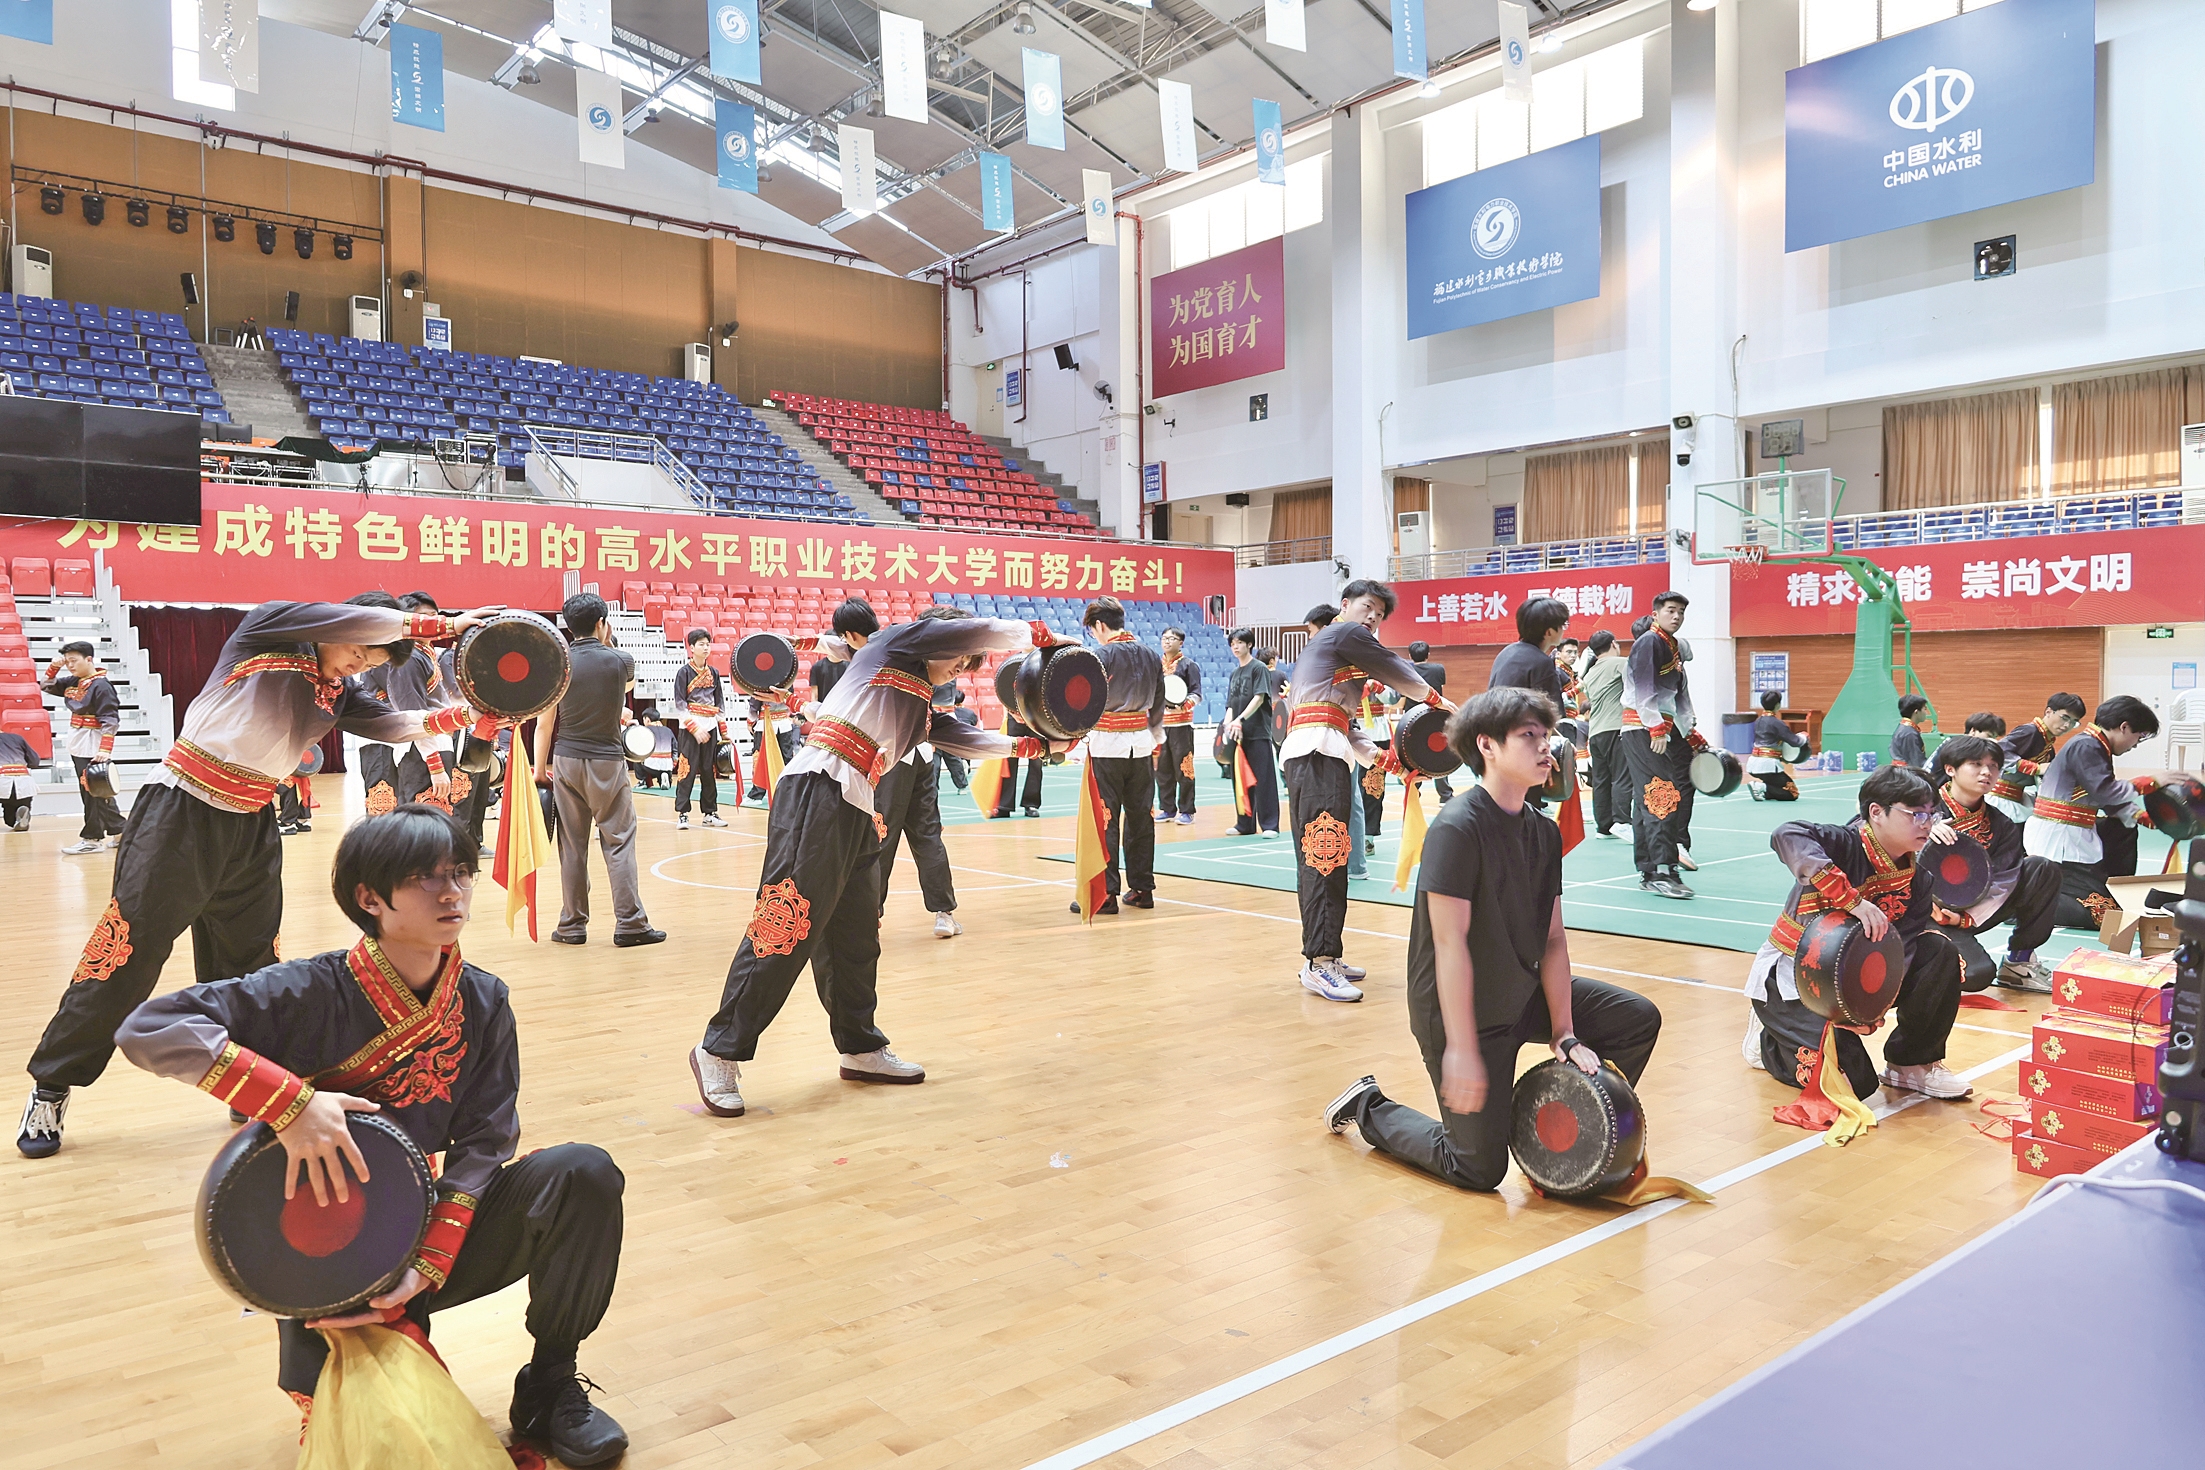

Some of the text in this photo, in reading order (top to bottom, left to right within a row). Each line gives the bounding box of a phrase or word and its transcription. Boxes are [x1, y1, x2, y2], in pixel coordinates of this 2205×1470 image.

[1883, 128, 1982, 172] 中国水利
[1883, 154, 1982, 188] CHINA WATER
[1168, 272, 1262, 327] 为党育人
[1446, 290, 1472, 301] Polytechnic
[1476, 285, 1490, 293] Water
[1490, 278, 1520, 290] Conservancy
[1519, 275, 1529, 283] and
[1529, 271, 1547, 281] Electric
[1547, 267, 1563, 276] Power
[1168, 315, 1262, 370] 为国育才
[1962, 552, 2132, 599] 崇尚文明
[1415, 589, 1508, 624] 上善若水
